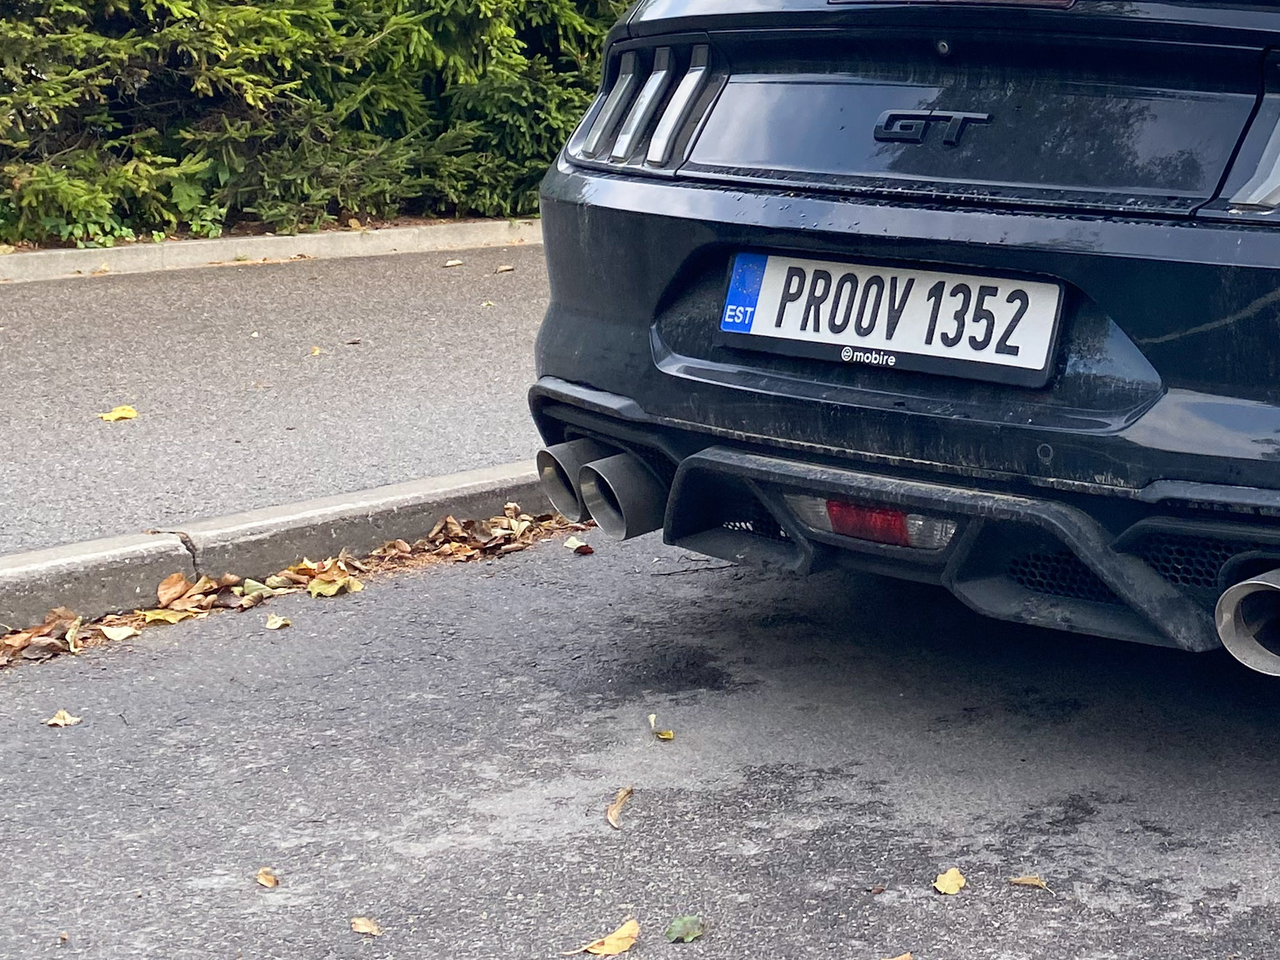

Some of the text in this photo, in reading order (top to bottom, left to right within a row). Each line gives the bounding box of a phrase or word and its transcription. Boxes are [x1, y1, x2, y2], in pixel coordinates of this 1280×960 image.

[873, 110, 994, 146] GT
[725, 305, 754, 324] EST
[774, 266, 1029, 357] PROOV 1352
